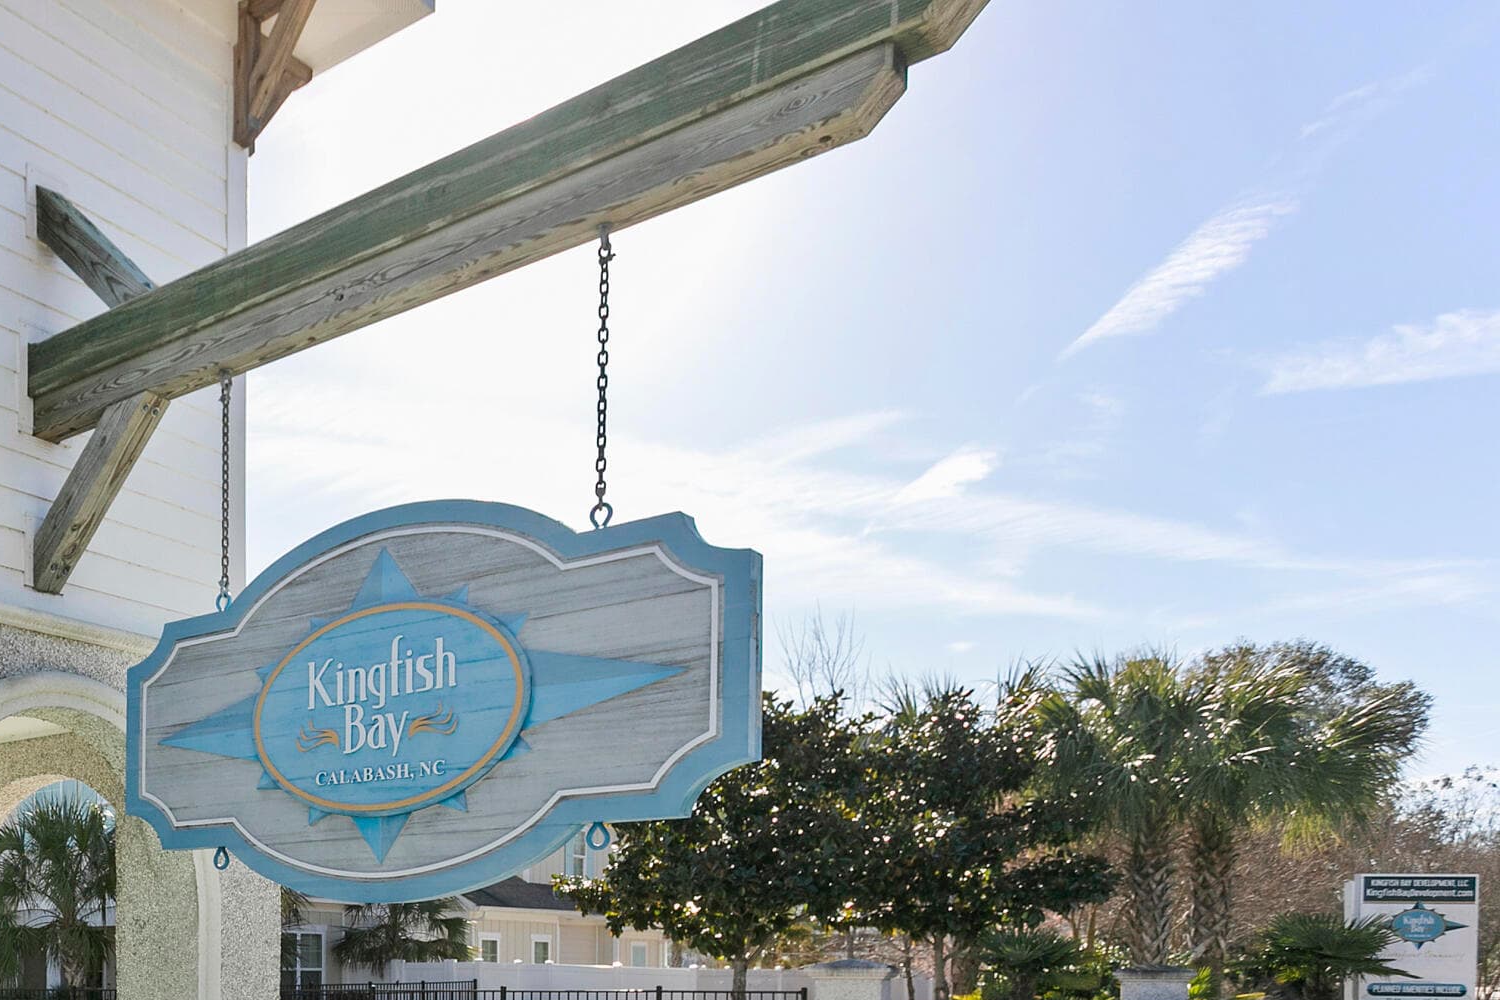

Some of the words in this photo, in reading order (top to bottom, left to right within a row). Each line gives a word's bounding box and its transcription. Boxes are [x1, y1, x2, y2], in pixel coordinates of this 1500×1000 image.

[306, 635, 457, 710] Kingfish
[343, 704, 407, 757] Bay
[315, 764, 416, 787] CALABASH,
[419, 759, 446, 778] NC
